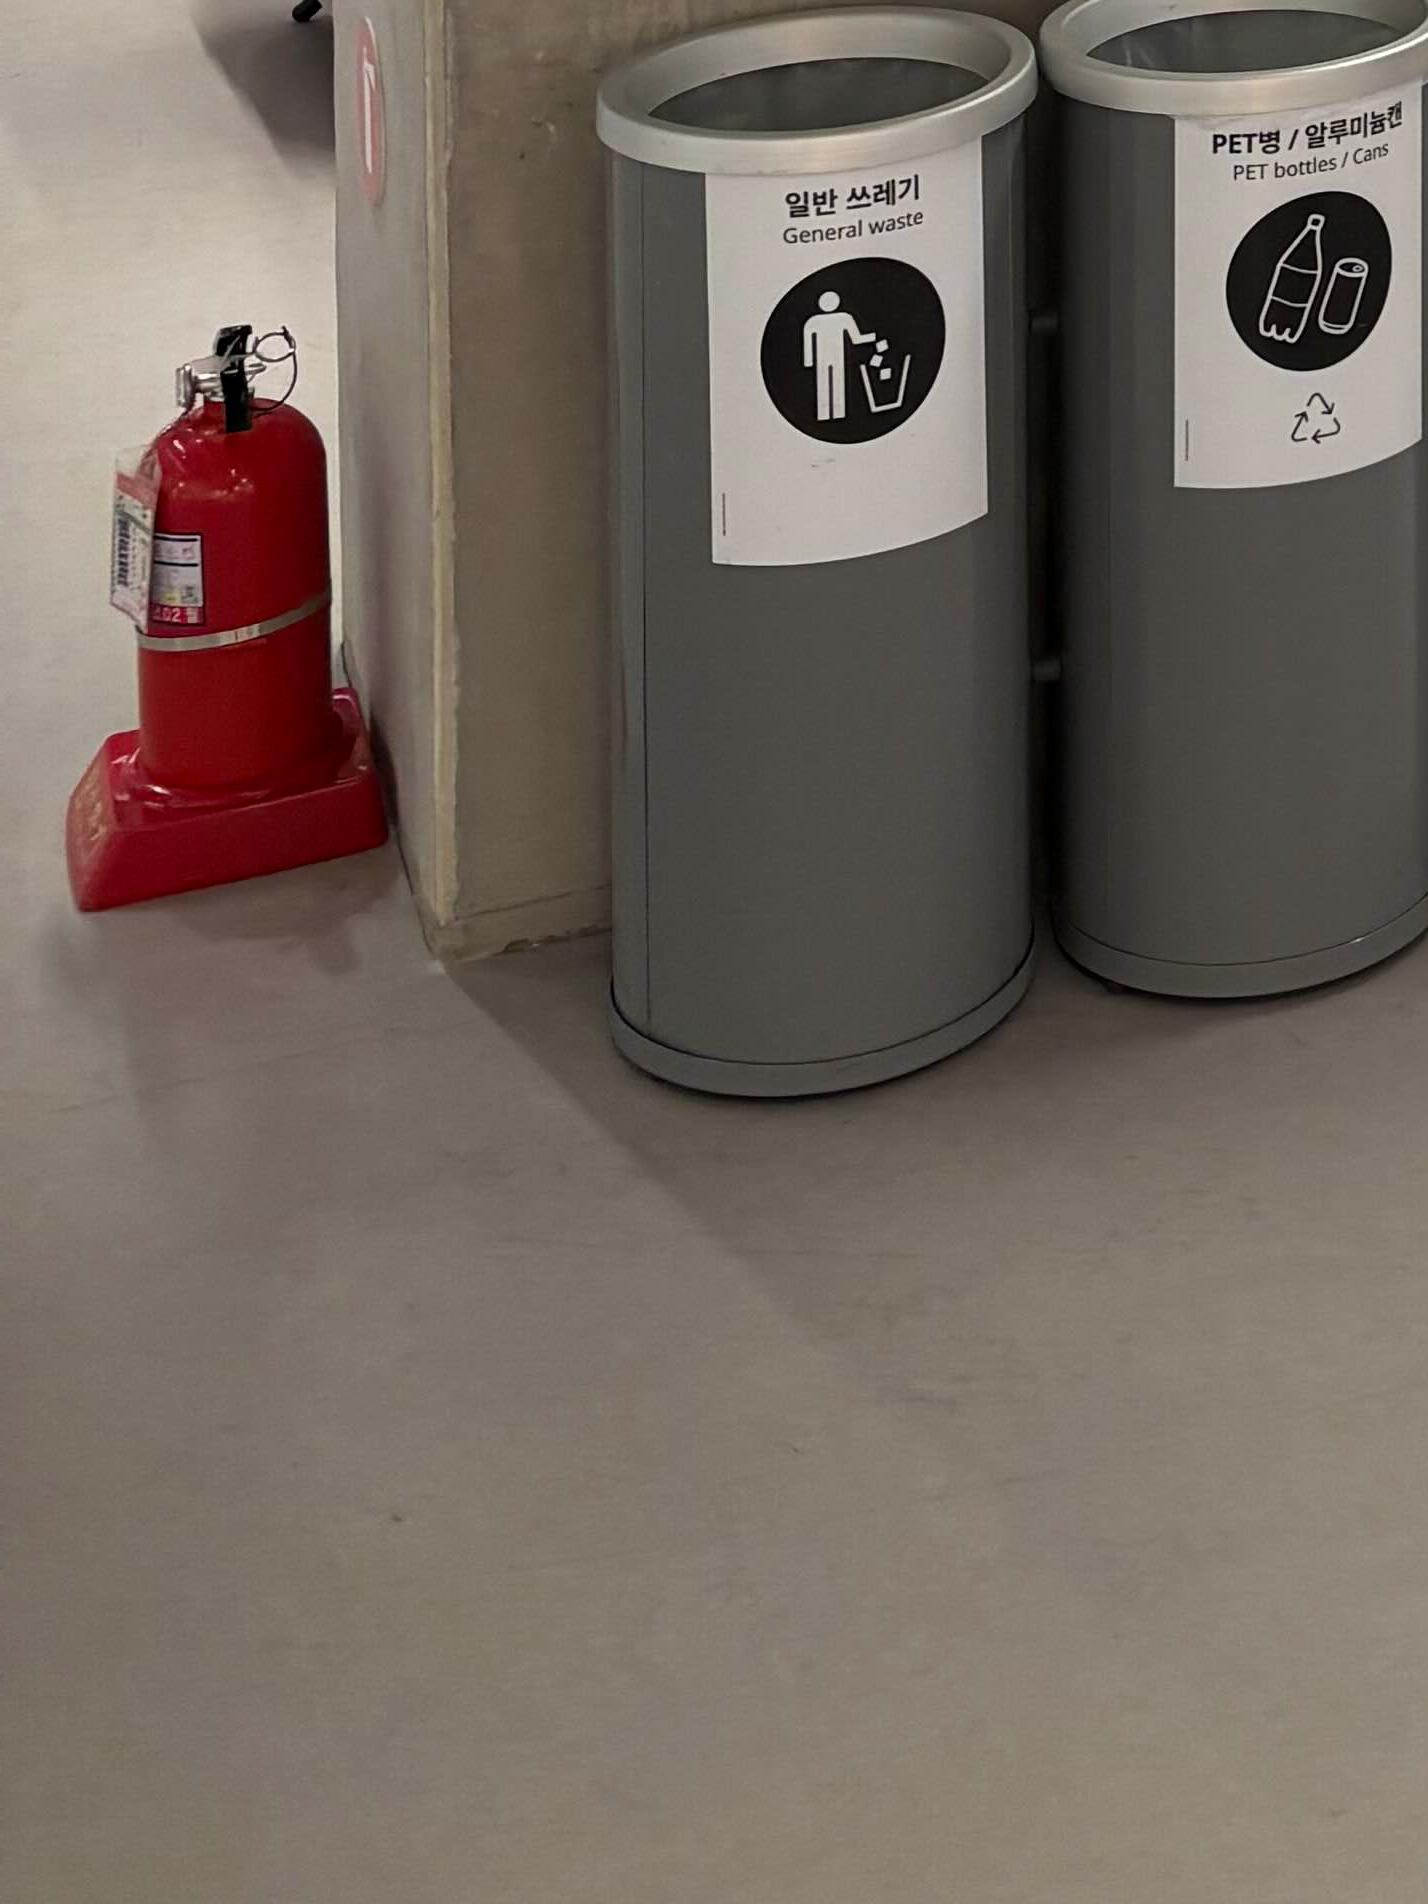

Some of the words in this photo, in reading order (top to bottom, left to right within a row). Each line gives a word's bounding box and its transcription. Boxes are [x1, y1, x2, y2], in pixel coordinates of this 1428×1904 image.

[1211, 129, 1281, 155] PET병
[1287, 128, 1300, 151] /
[1304, 100, 1403, 150] 알루미늄캔
[1233, 163, 1269, 182] PET
[1274, 156, 1338, 179] bottles
[1340, 151, 1350, 169] /
[1352, 143, 1390, 166] Cans
[785, 188, 839, 219] 일반
[846, 173, 920, 211] 쓰레기
[782, 219, 863, 244] General
[867, 211, 925, 235] waste
